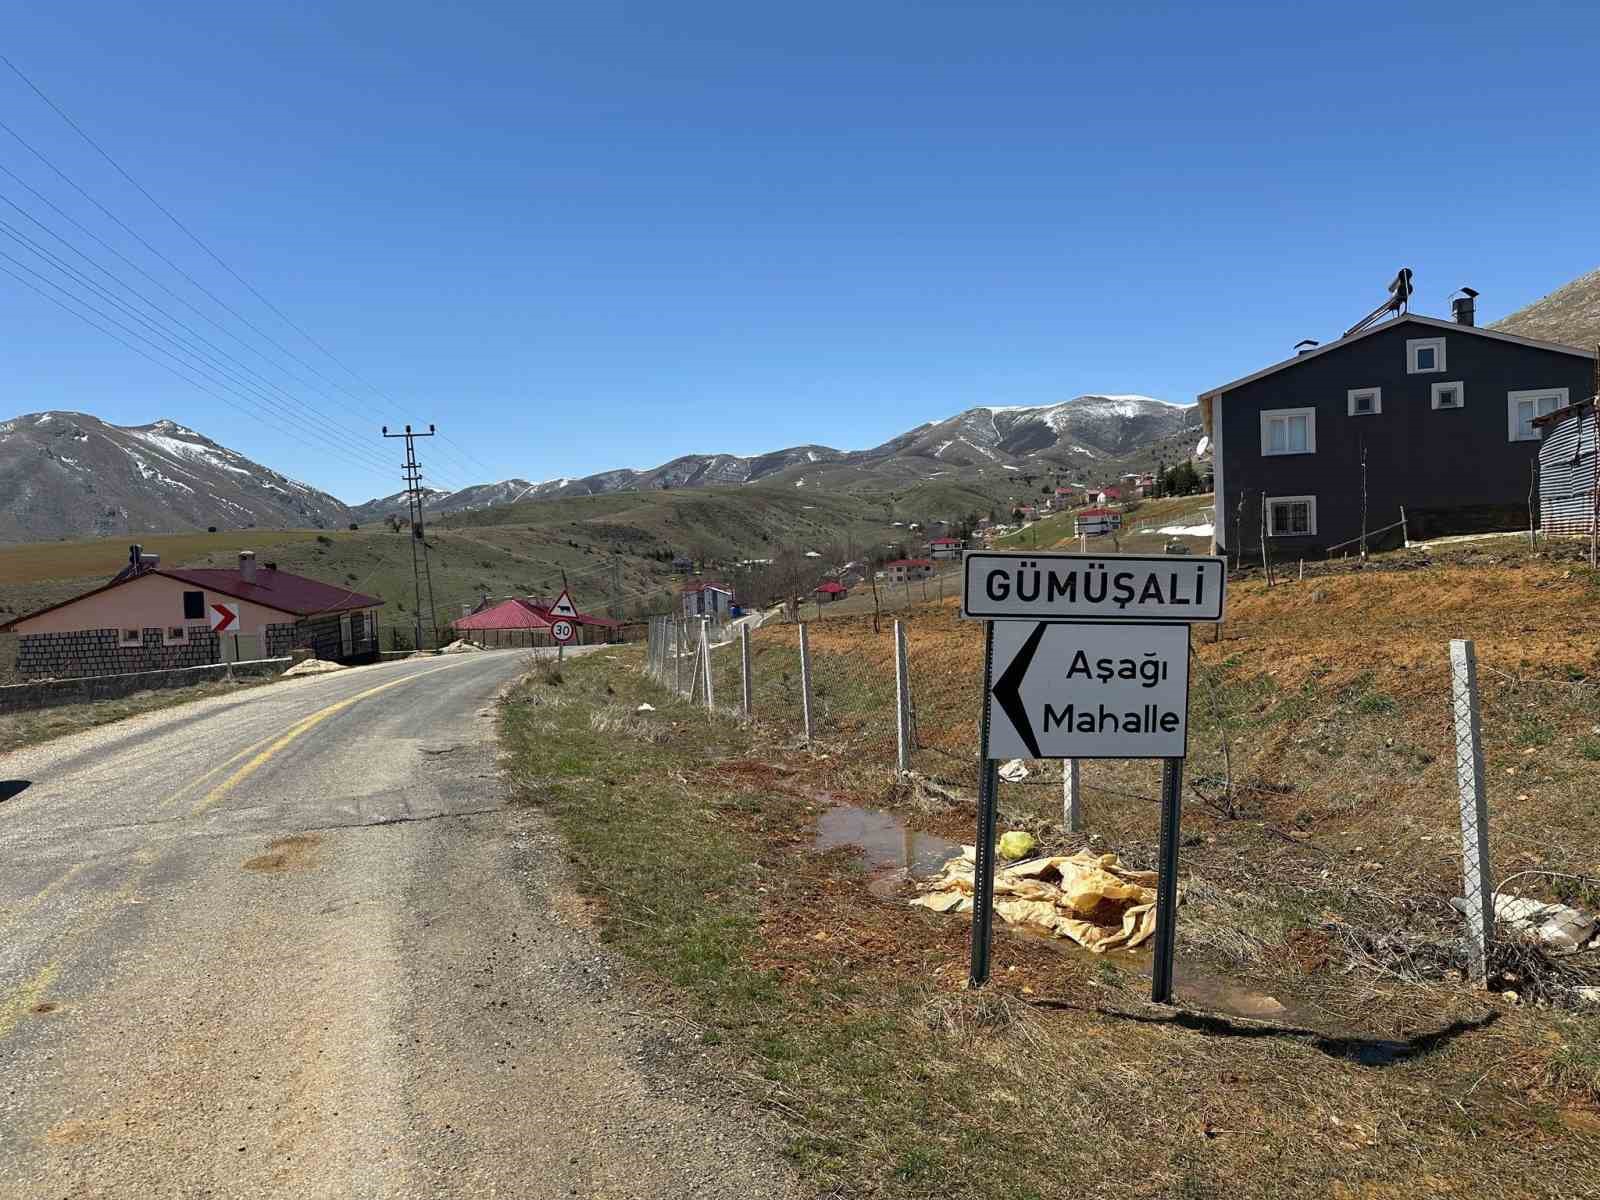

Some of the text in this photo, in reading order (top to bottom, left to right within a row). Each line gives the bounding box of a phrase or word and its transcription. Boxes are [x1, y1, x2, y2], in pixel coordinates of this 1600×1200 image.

[985, 561, 1205, 609] GÜMÜŞALİ
[555, 624, 570, 636] 30
[1066, 650, 1168, 688] Aşağı
[1043, 704, 1180, 733] Mahalle
